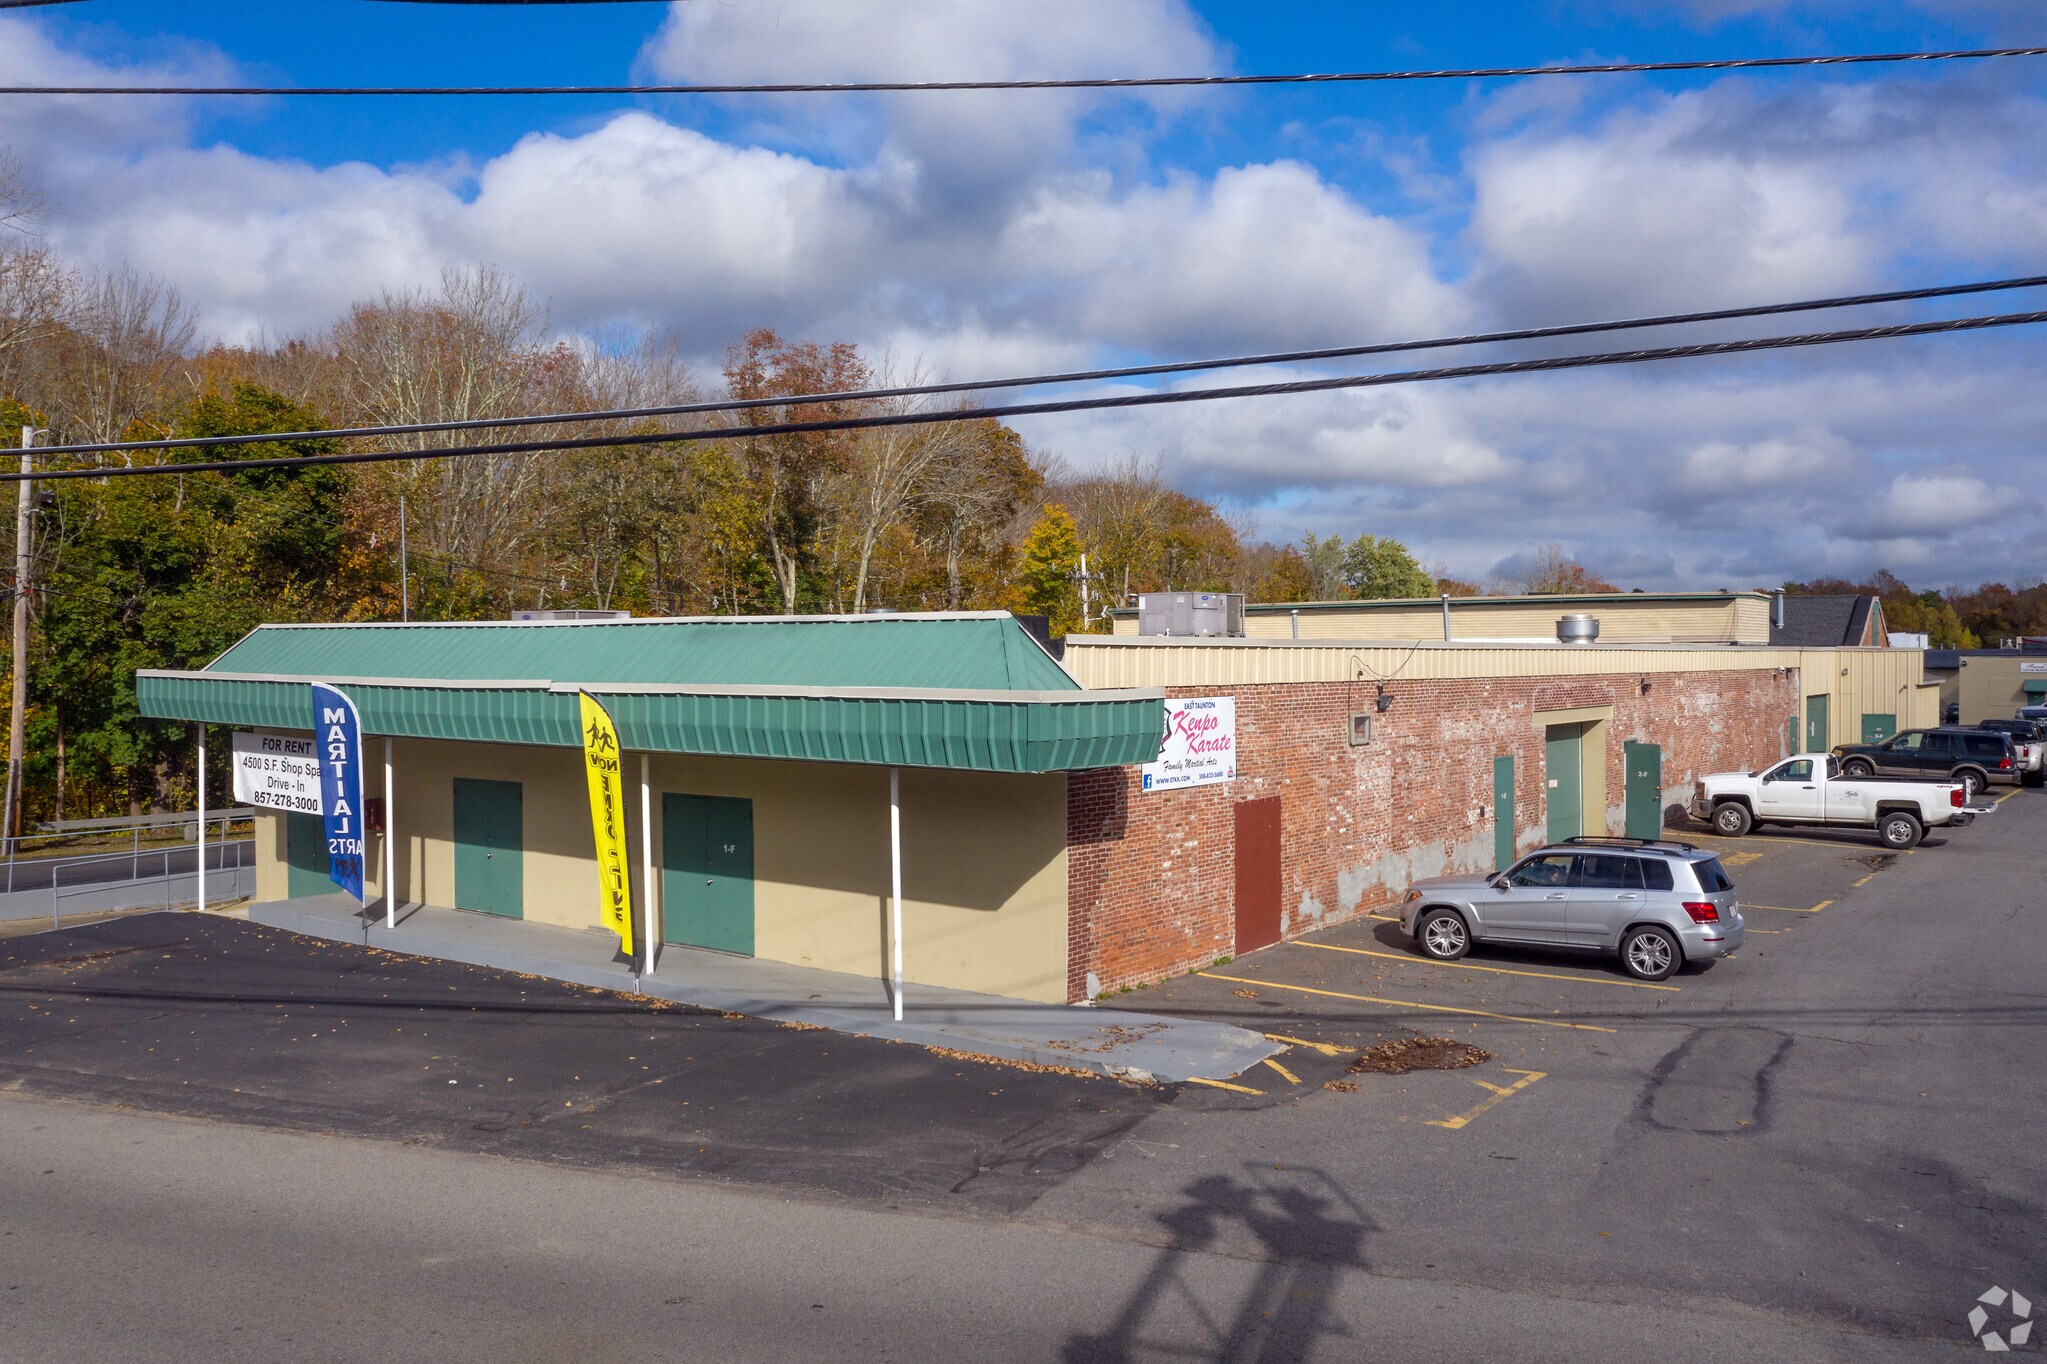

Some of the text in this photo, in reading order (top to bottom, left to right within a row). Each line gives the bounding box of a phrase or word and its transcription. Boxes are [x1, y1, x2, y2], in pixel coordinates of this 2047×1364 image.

[1184, 701, 1216, 710] EAST TAUNTON
[1173, 710, 1219, 738] Kenpo
[262, 737, 312, 755] FOR RENT
[1185, 732, 1232, 755] Karate
[242, 756, 262, 770] 4500
[264, 758, 279, 772] S.F.
[280, 760, 303, 777] Shop
[1163, 756, 1218, 773] Family Martial Arts
[267, 776, 290, 791] Drive
[296, 778, 305, 793] In
[254, 790, 318, 812] 857-278-3000
[723, 844, 736, 854] 1-F
